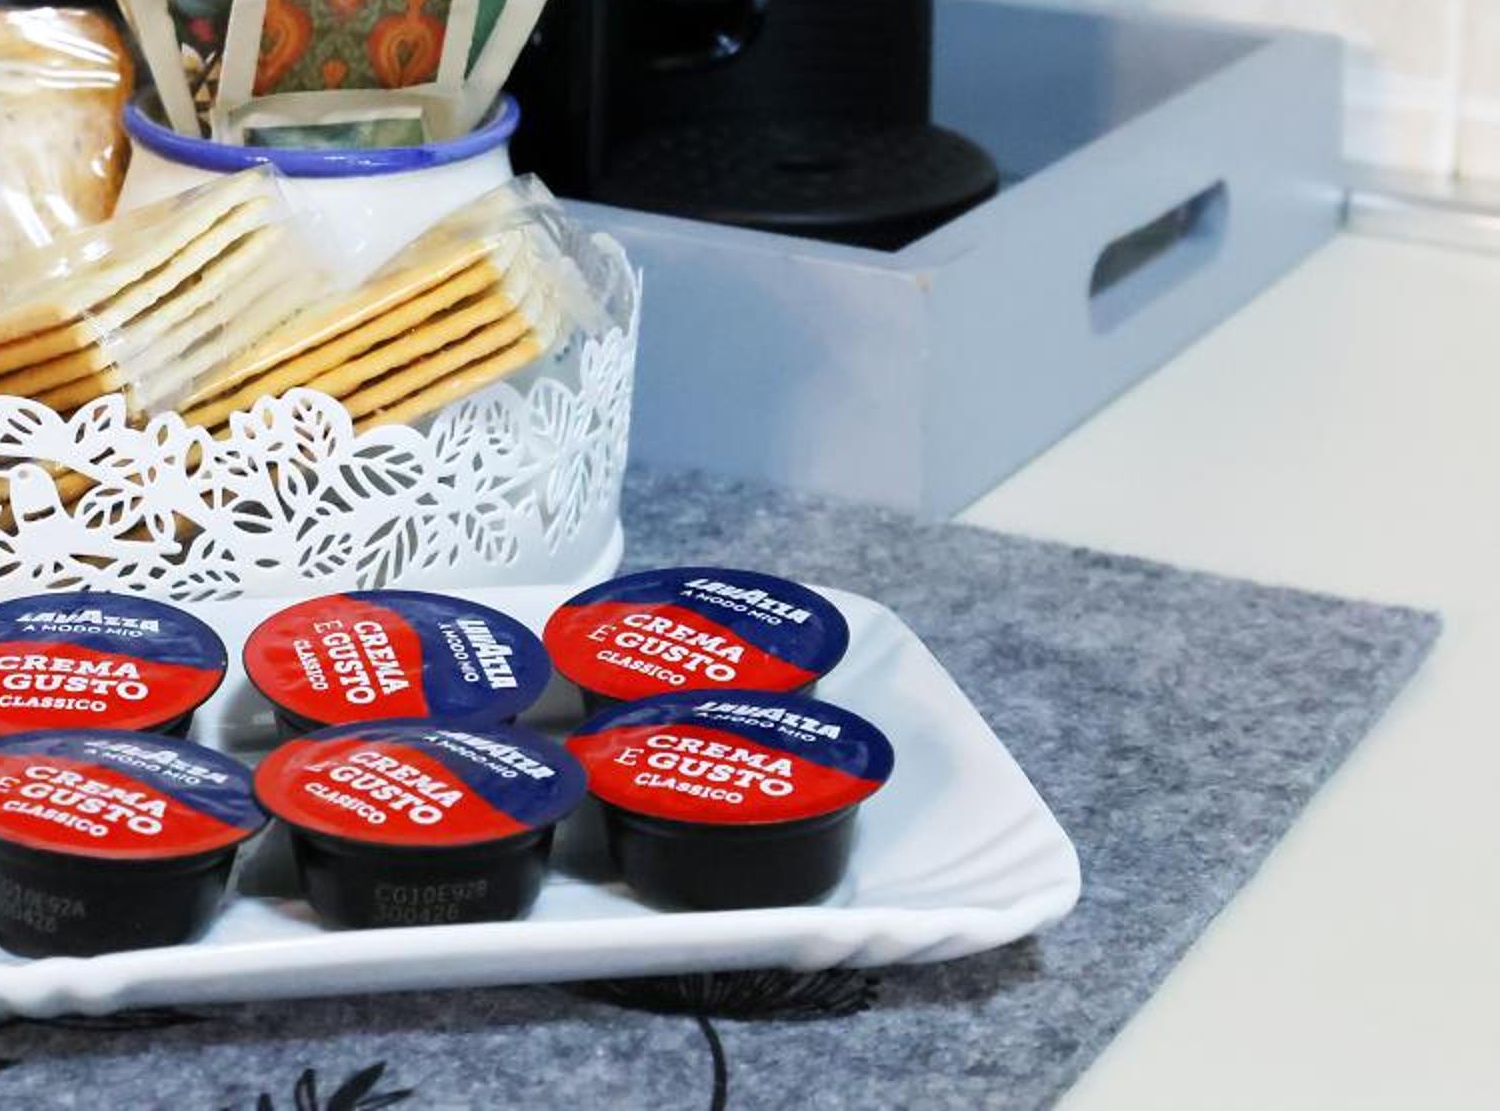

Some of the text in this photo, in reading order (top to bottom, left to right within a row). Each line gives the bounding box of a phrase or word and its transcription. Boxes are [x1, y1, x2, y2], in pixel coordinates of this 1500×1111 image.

[15, 610, 159, 633] LAVAZZA
[684, 578, 812, 624] LAVAZZA
[696, 592, 748, 613] MODO
[748, 609, 782, 626] MIO
[40, 624, 101, 634] MODO
[106, 627, 144, 638] MIO
[457, 619, 518, 689] LAVAZZA
[588, 624, 738, 682] E GUSTO
[622, 614, 746, 663] CREMA
[293, 640, 329, 690] CLASSICO
[314, 620, 377, 704] E GUSTO
[354, 620, 412, 695] CREMA
[441, 629, 469, 660] MODO
[457, 659, 480, 682] MIO
[597, 650, 686, 685] CLASSICO
[3, 673, 149, 700] GUSTO
[694, 701, 841, 740] LAVAZZA
[712, 714, 774, 729] MODO
[777, 725, 817, 742] MIO
[350, 752, 464, 807] CREMA
[614, 747, 794, 796] E GUSTO
[647, 735, 794, 777] CREMA
[19, 782, 163, 835] GUSTO
[25, 765, 167, 818] CREMA
[304, 783, 387, 824] CLASSICO
[329, 766, 443, 824] GUSTO
[634, 773, 744, 804] CLASSICO
[3, 800, 108, 837] CLASSICO
